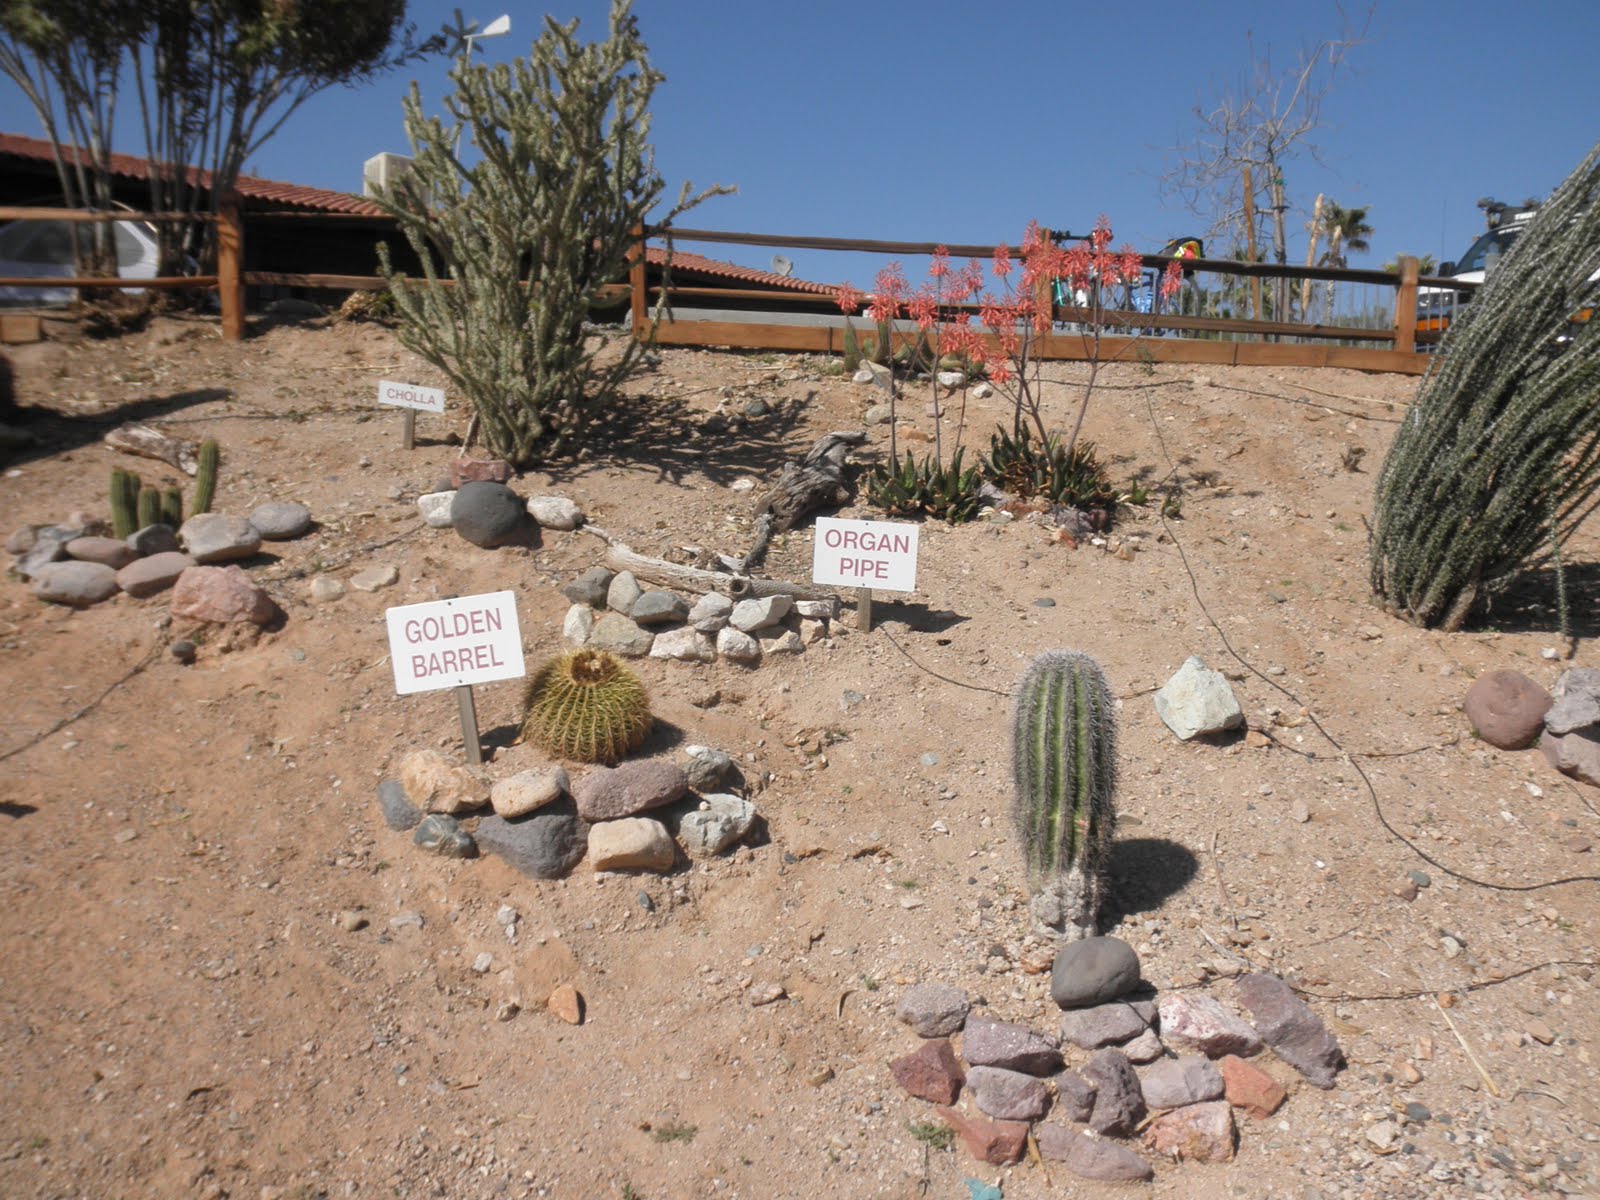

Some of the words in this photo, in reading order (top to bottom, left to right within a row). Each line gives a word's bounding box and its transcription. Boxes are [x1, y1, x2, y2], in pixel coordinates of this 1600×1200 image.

[387, 388, 435, 405] CHOLLA
[825, 529, 909, 553] ORGAN
[840, 558, 889, 579] PIPE
[405, 608, 502, 644] GOLDEN
[412, 644, 504, 678] BARREL
